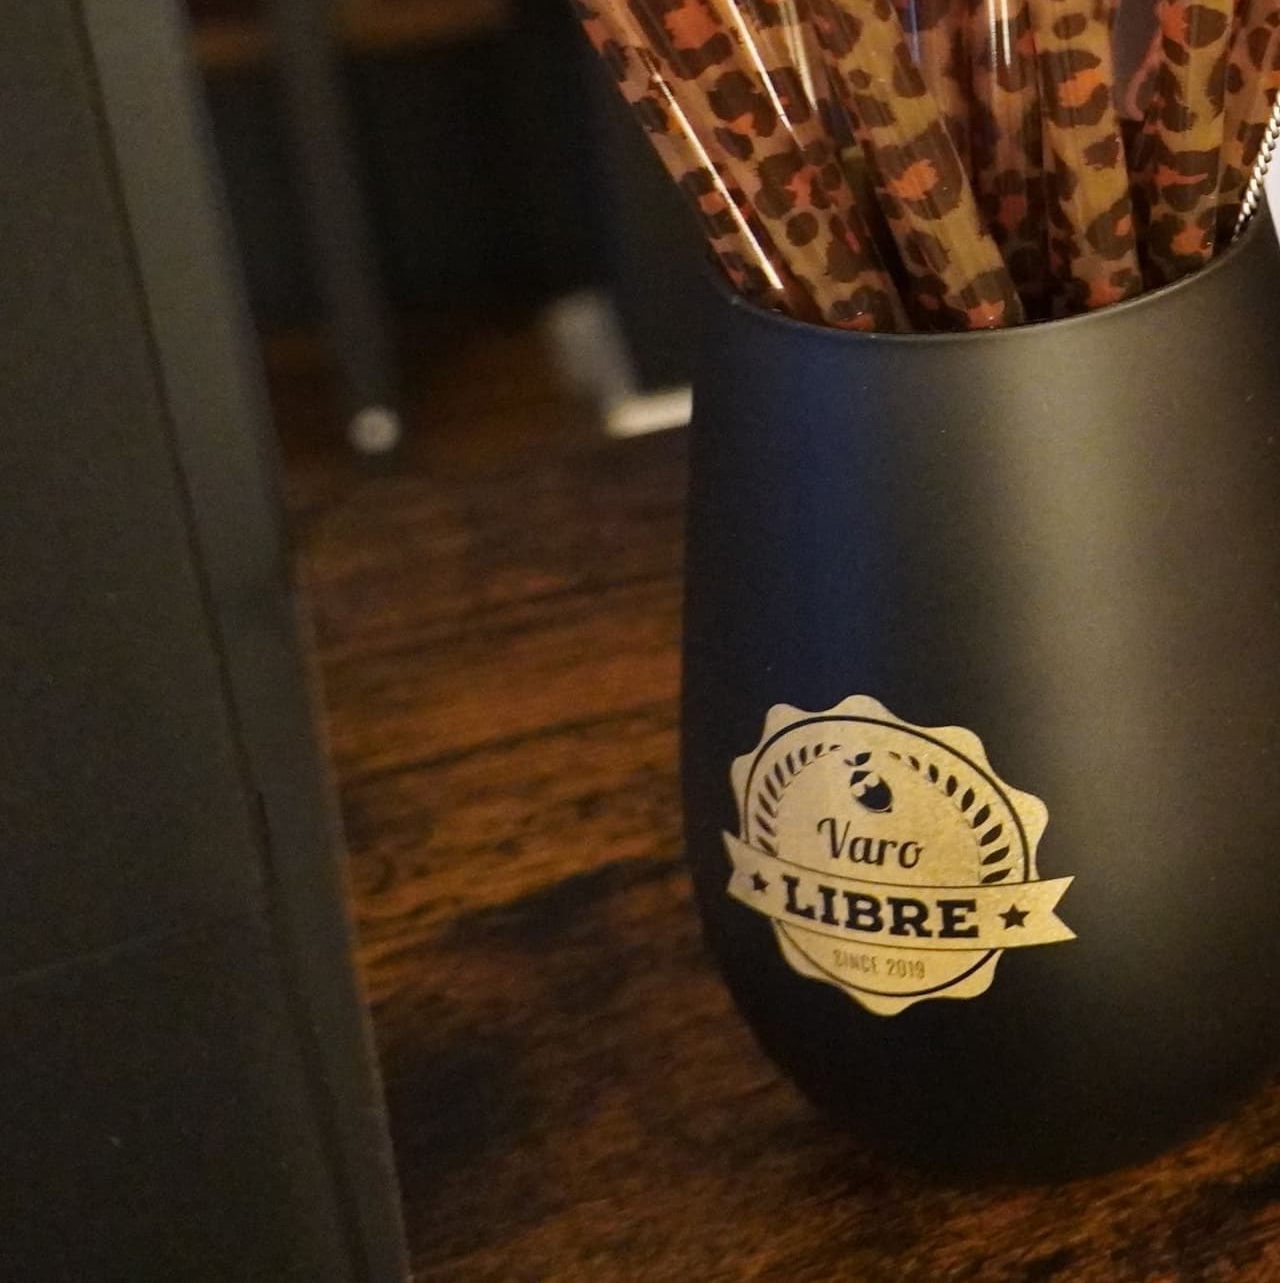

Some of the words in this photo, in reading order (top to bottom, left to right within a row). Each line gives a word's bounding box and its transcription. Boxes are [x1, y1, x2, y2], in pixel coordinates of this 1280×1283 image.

[816, 817, 925, 869] Varo
[780, 872, 980, 939] LIBRE
[833, 949, 880, 975] SINCE
